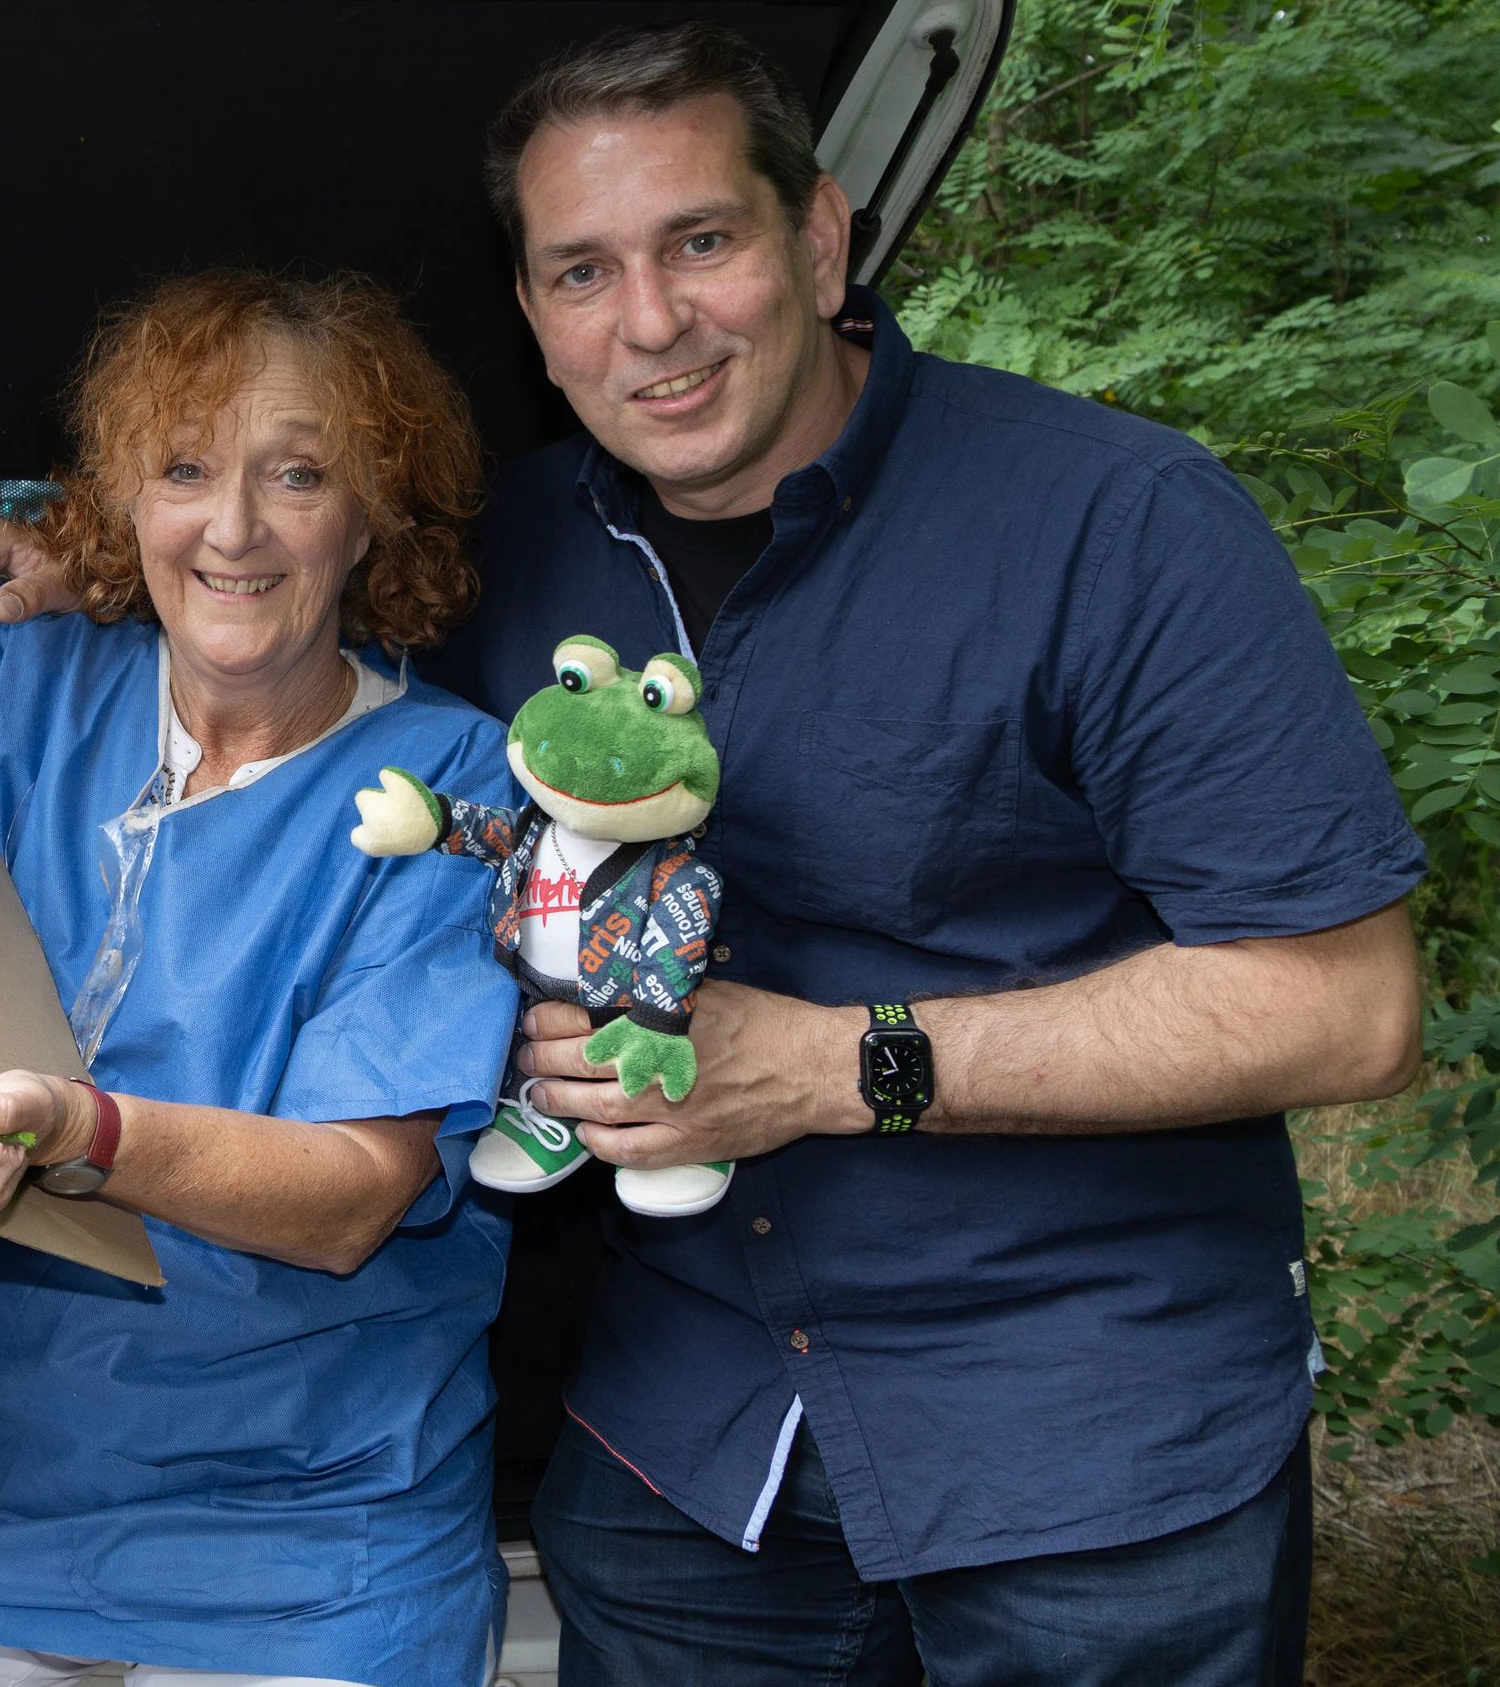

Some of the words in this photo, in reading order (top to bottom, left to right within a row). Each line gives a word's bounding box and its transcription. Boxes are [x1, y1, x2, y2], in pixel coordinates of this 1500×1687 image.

[695, 866, 721, 899] Nice
[579, 912, 631, 973] aris
[645, 974, 678, 1012] Nice
